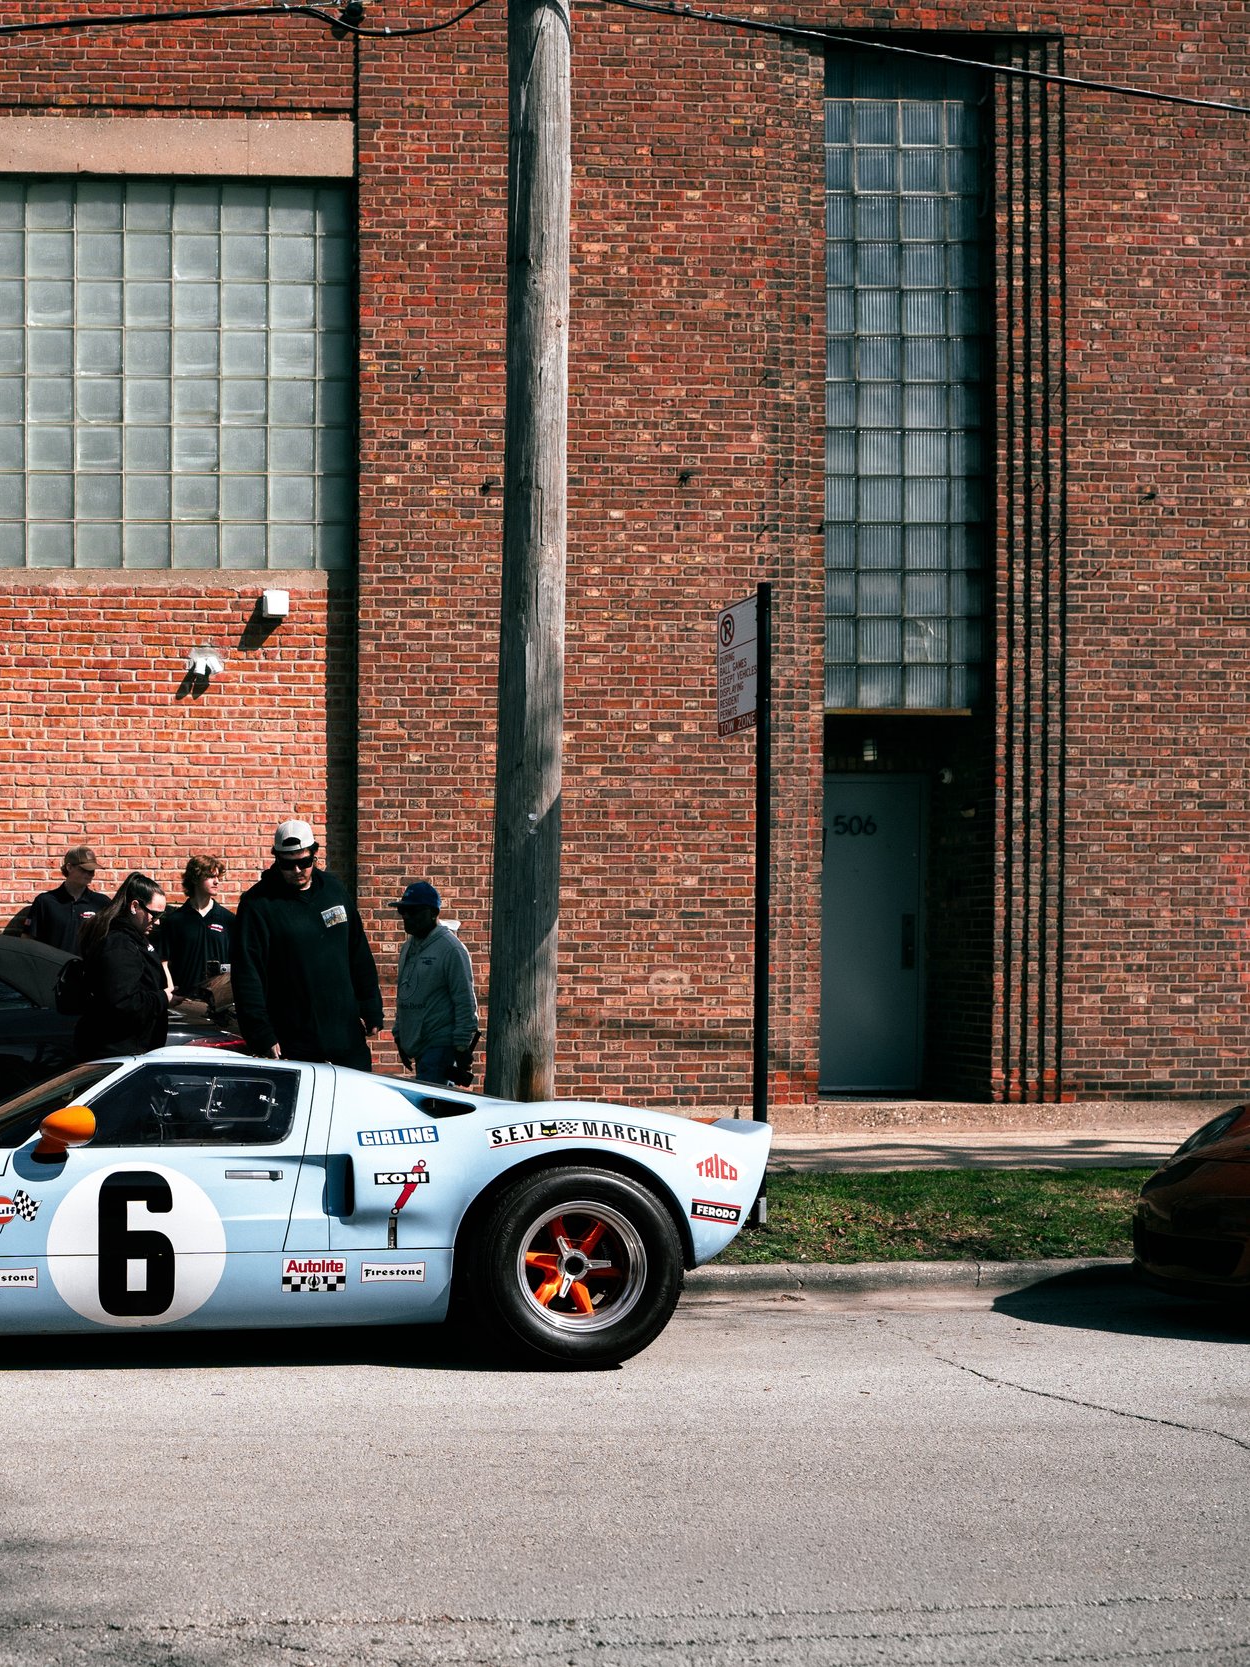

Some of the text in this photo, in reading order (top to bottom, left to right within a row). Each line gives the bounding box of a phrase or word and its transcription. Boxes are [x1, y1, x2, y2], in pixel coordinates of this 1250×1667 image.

[720, 652, 735, 666] DURING
[720, 658, 747, 677] BALL GAMES
[720, 665, 757, 688] EXCEPT VEHICLES
[720, 682, 744, 699] DISPLAYING
[720, 695, 740, 710] RESIDENT
[720, 706, 738, 720] PERMITS
[720, 712, 756, 735] TOW ZONE
[833, 814, 877, 836] 506
[360, 1126, 437, 1146] GIRLING
[582, 1121, 674, 1151] MARCHAL
[696, 1153, 738, 1181] TRICO
[376, 1172, 427, 1184] KONI
[696, 1204, 737, 1220] FERODO
[98, 1170, 175, 1317] 6
[285, 1259, 344, 1274] Autolite
[363, 1268, 423, 1278] Firestone
